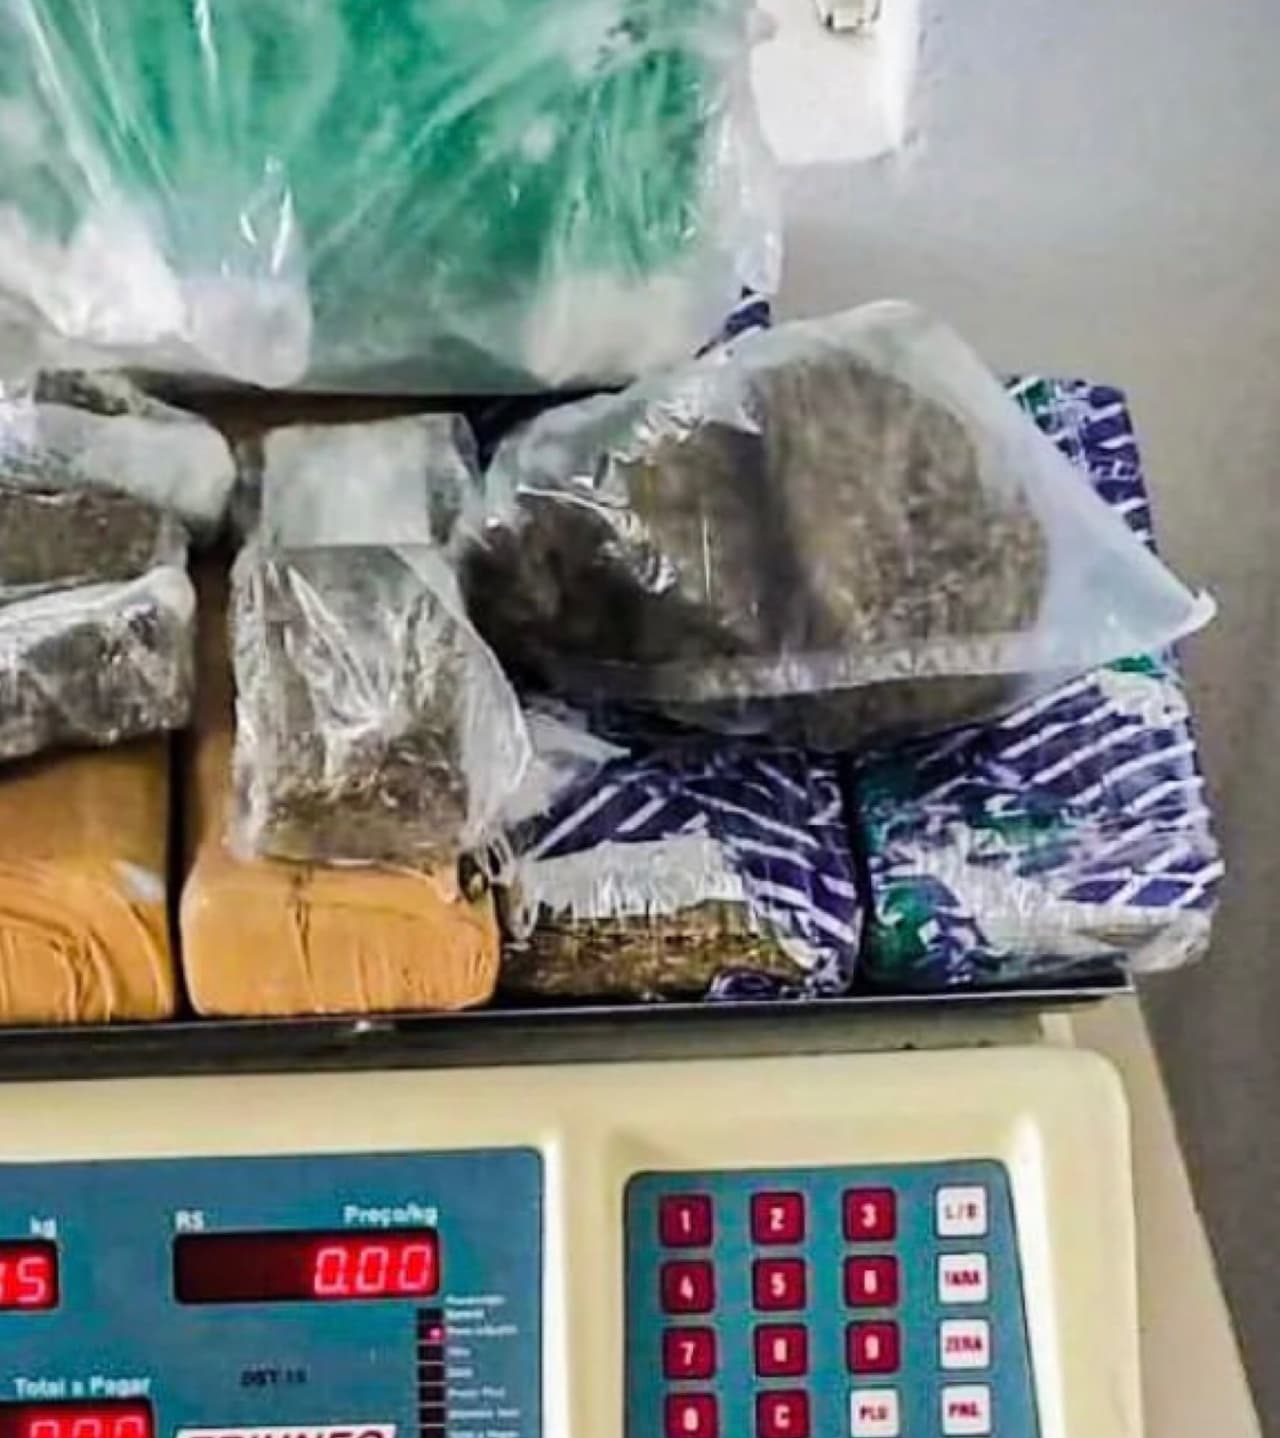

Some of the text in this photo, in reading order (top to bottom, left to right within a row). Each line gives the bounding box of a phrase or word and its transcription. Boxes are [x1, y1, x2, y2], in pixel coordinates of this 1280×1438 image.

[680, 1209, 690, 1232] 1
[770, 1207, 784, 1231] 2
[861, 1203, 877, 1228] 3
[680, 1276, 694, 1299] 4
[771, 1272, 785, 1297] 5
[680, 1341, 695, 1365] 7
[864, 1334, 879, 1360] 9
[13, 1377, 65, 1400] Total
[90, 1376, 151, 1397] Pagar
[774, 1404, 790, 1428] C
